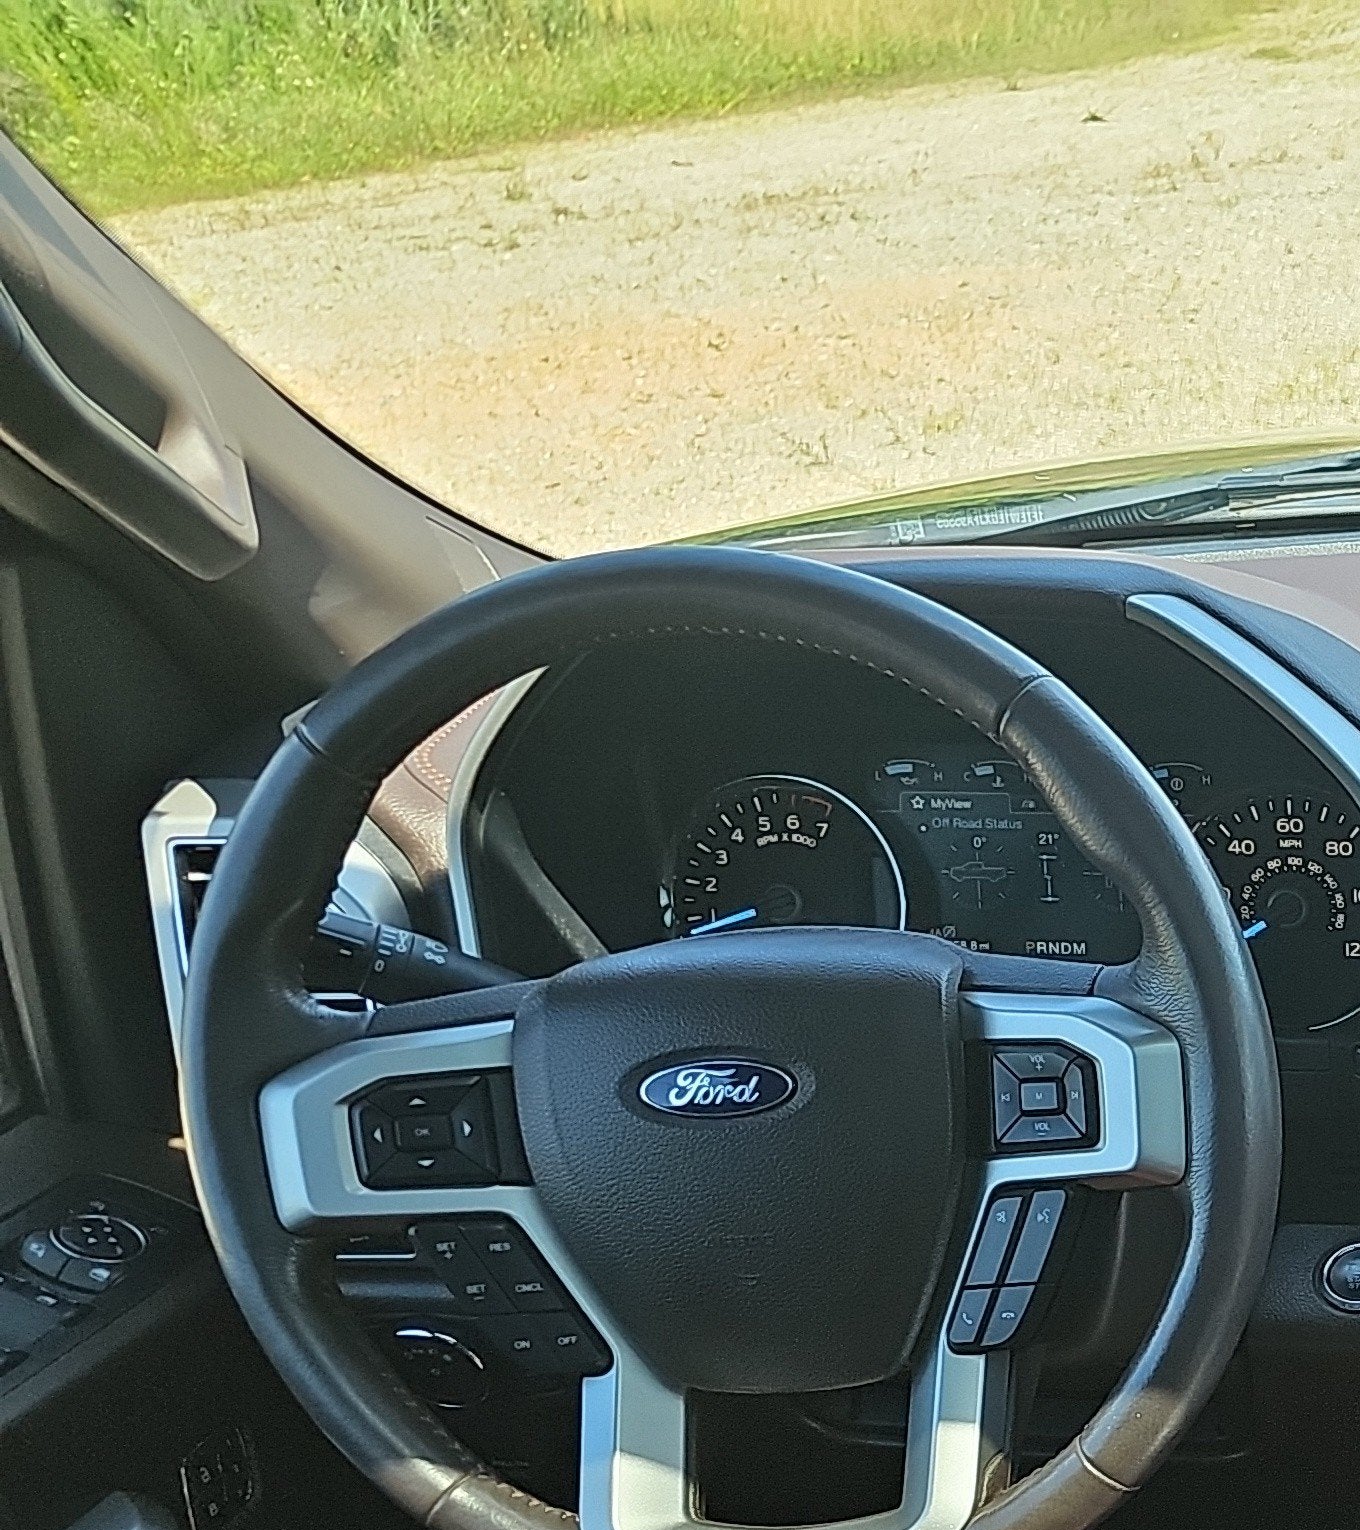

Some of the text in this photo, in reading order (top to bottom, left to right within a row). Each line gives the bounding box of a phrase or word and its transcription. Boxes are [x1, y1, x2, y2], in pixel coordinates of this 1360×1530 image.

[930, 798, 973, 810] MyView
[758, 817, 771, 832] 5
[786, 815, 800, 829] 6
[953, 818, 982, 829] Road
[985, 818, 1022, 829] Status
[1276, 818, 1304, 833] 60
[731, 828, 745, 843] 4
[816, 823, 829, 838] 7
[757, 834, 778, 847] RPM
[791, 833, 817, 848] 1000
[1227, 840, 1255, 855] 40
[1279, 839, 1302, 848] MPH
[1325, 841, 1353, 856] 80
[715, 850, 728, 864] 3
[1267, 858, 1281, 870] 80
[1287, 857, 1303, 866] 100
[1251, 868, 1265, 881] 60
[1307, 861, 1323, 874] 120
[705, 877, 718, 892] 2
[1242, 885, 1253, 900] 40
[1240, 905, 1250, 920] 20
[1028, 1053, 1046, 1065] VOL
[668, 1068, 760, 1107] Ford
[1033, 1121, 1050, 1131] VOL
[466, 1284, 487, 1294] SET
[513, 1340, 531, 1349] ON
[557, 1335, 578, 1346] OFF
